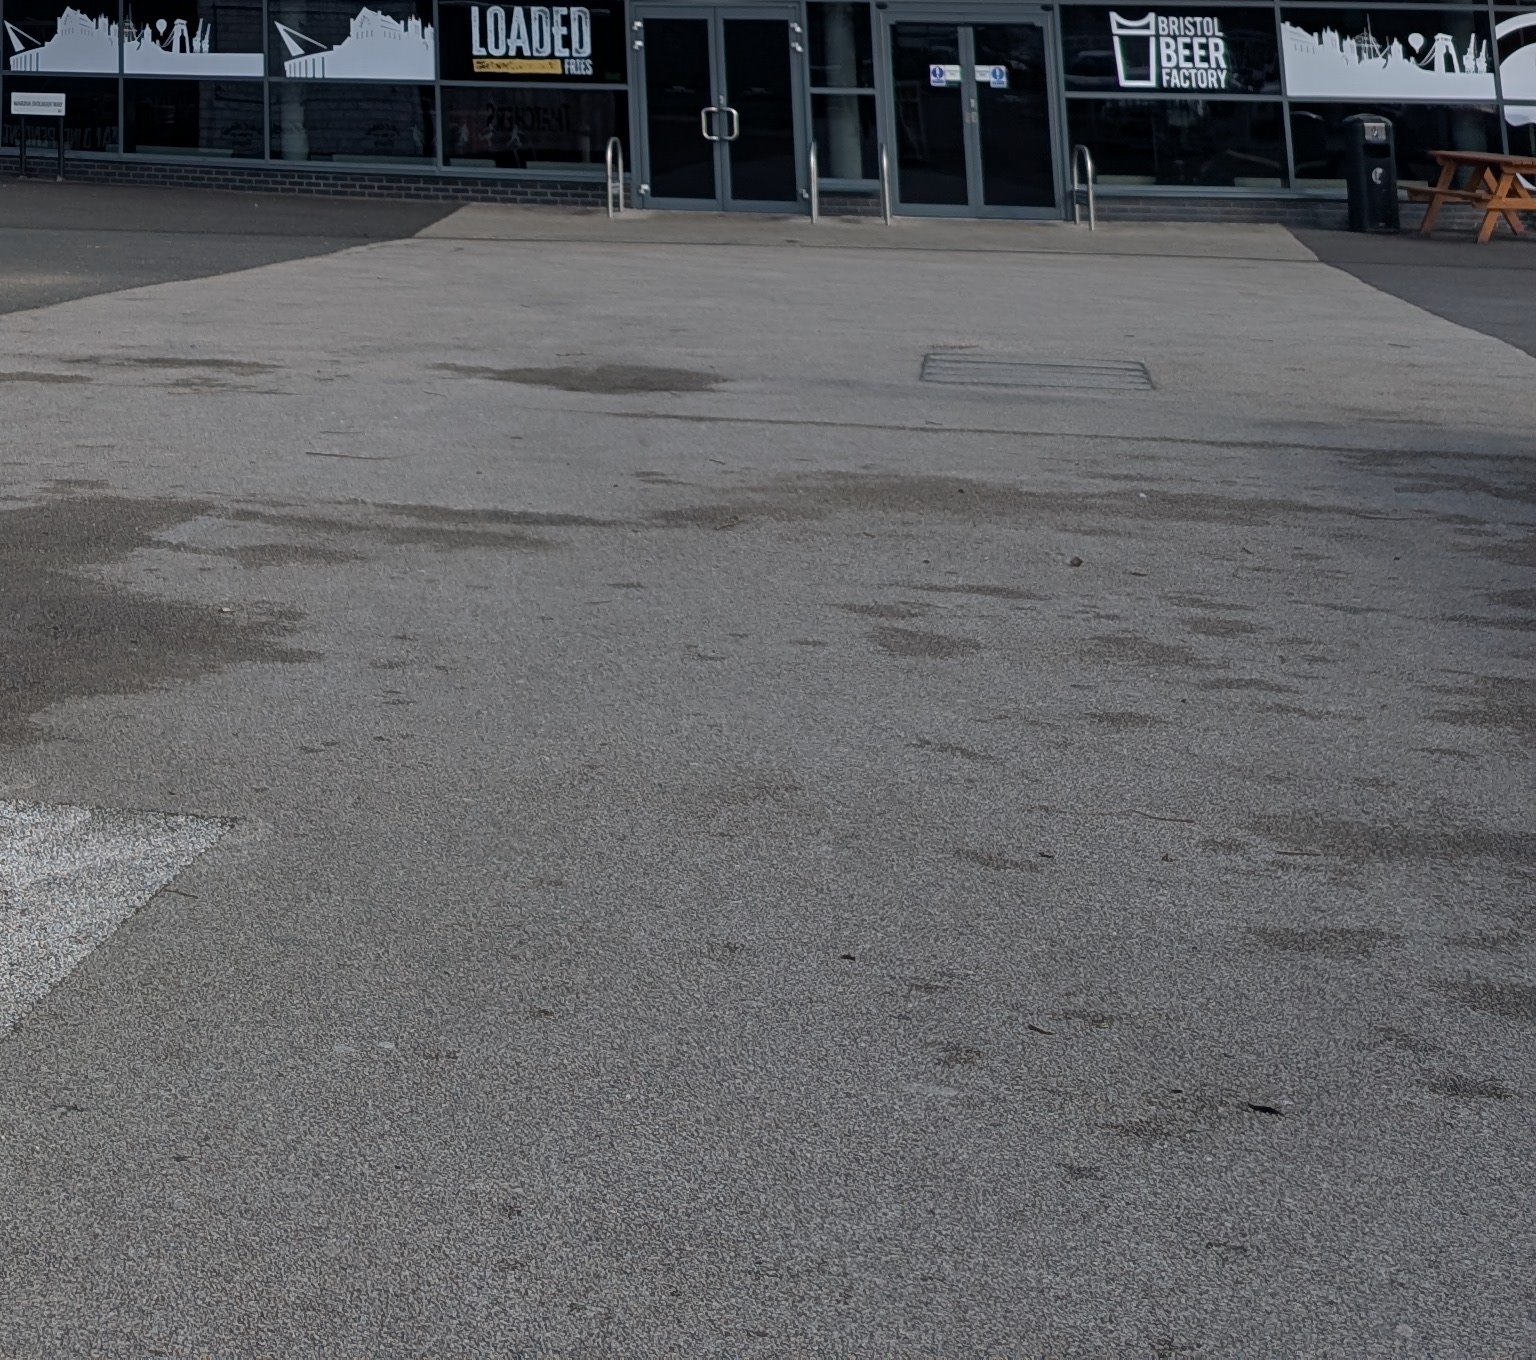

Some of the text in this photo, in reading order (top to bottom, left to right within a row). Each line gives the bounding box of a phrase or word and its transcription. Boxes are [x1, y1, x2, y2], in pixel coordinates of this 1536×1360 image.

[470, 5, 591, 57] LOADED
[1157, 15, 1224, 37] BRISTOL
[1159, 36, 1227, 69] BEER
[564, 58, 593, 76] FRIES
[1162, 68, 1227, 88] FACTORY
